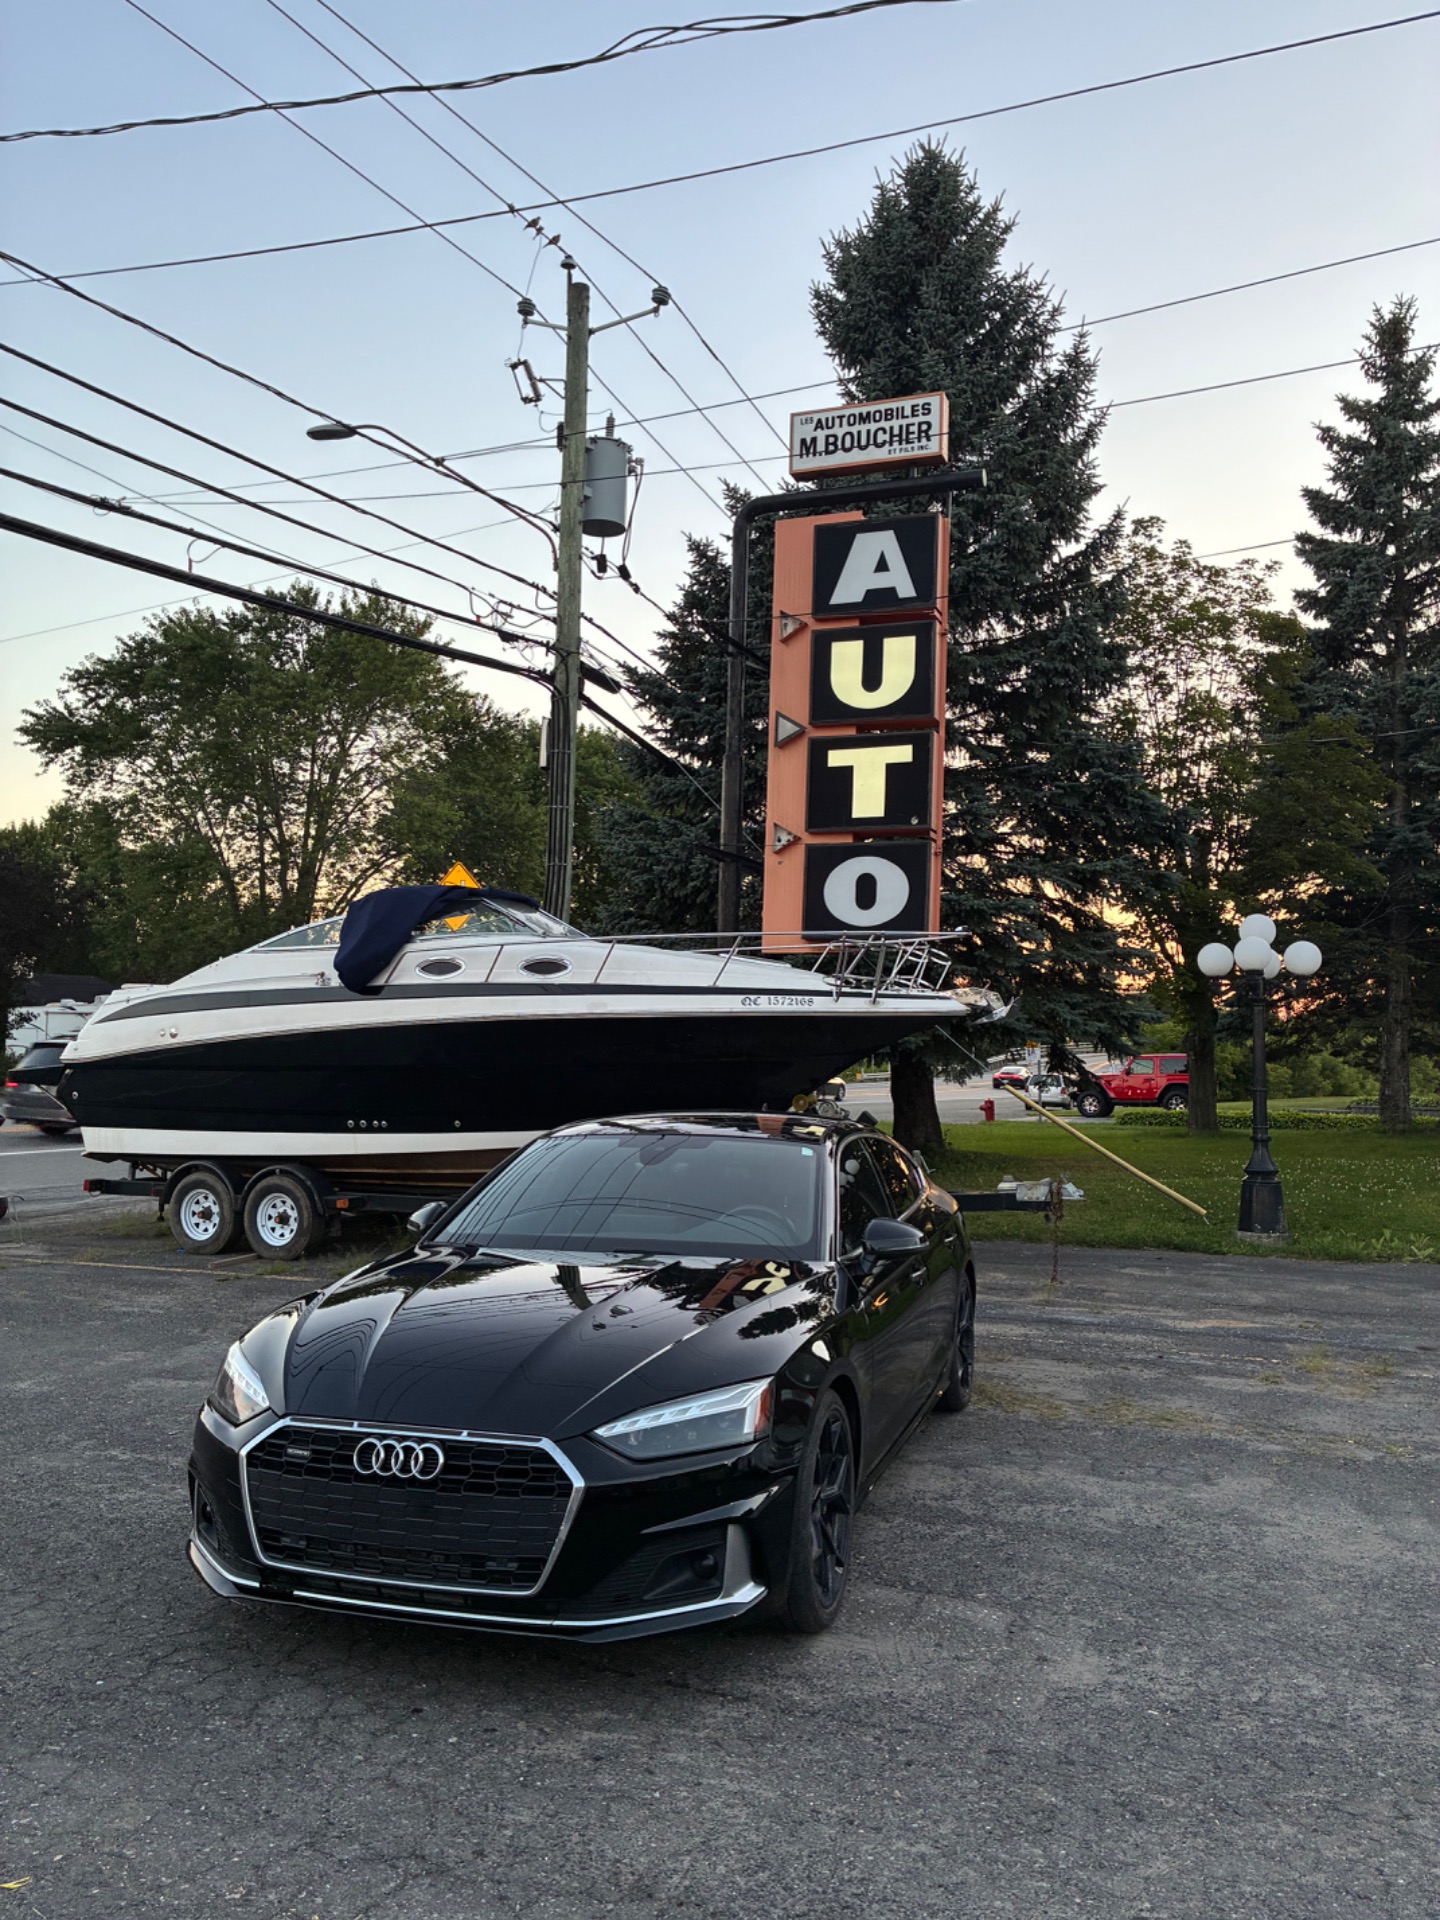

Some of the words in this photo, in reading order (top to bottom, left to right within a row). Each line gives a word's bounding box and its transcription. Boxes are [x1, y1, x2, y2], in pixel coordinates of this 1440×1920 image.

[800, 416, 814, 426] LES
[813, 402, 932, 432] AUTOMOBILES
[823, 529, 917, 927] AUTO
